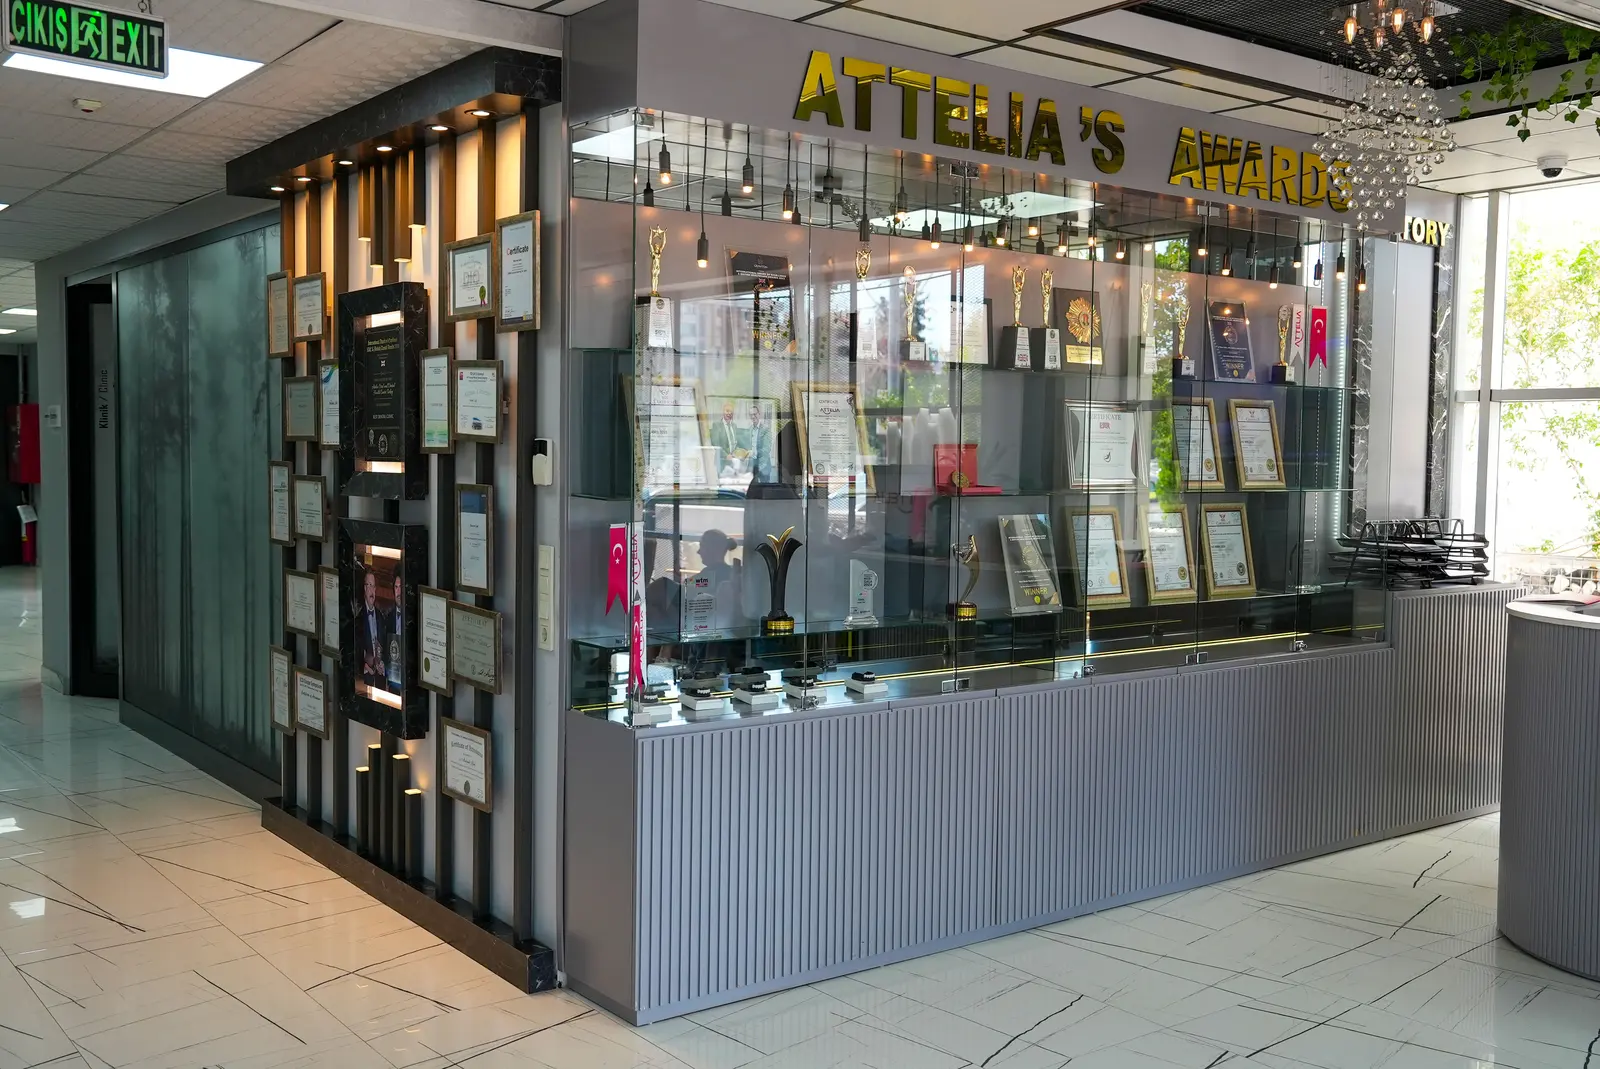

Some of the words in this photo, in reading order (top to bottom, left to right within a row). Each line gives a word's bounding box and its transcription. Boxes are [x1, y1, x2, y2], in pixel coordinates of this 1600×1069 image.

[112, 18, 164, 69] EXIT
[793, 50, 1125, 174] ATTELIA'S
[98, 369, 108, 393] Clinic
[98, 404, 109, 429] Klinik
